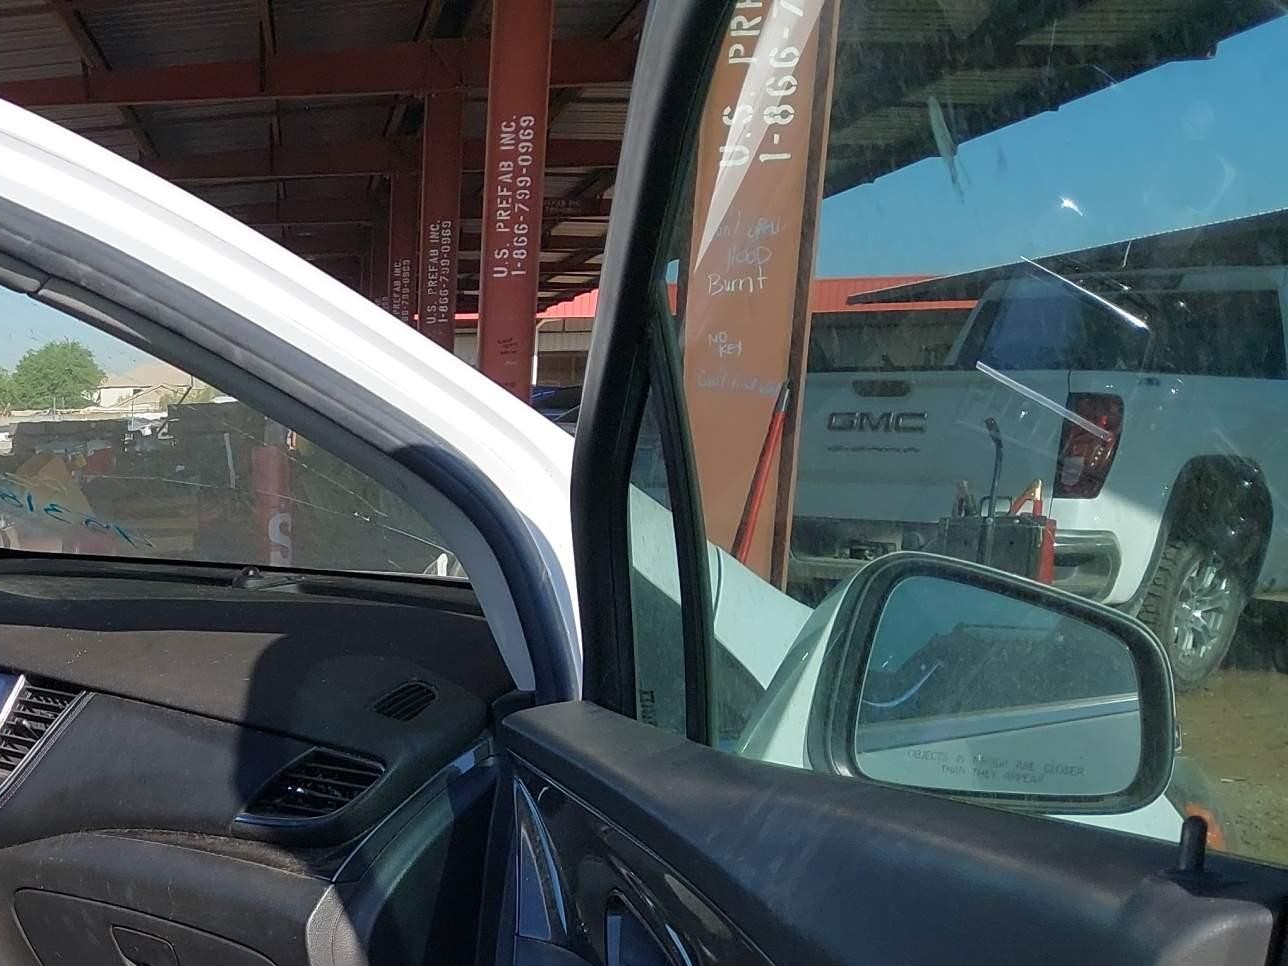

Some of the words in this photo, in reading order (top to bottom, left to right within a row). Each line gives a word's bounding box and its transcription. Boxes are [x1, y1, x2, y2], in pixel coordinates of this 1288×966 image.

[728, 0, 763, 64] PR
[500, 115, 516, 150] INC.
[719, 91, 755, 167] U.S.
[496, 160, 514, 233] PREFAB
[511, 115, 535, 277] 1-866-799-0969
[428, 249, 439, 295] PREFAB
[492, 243, 510, 279] U.S.
[827, 411, 929, 433] GMC
